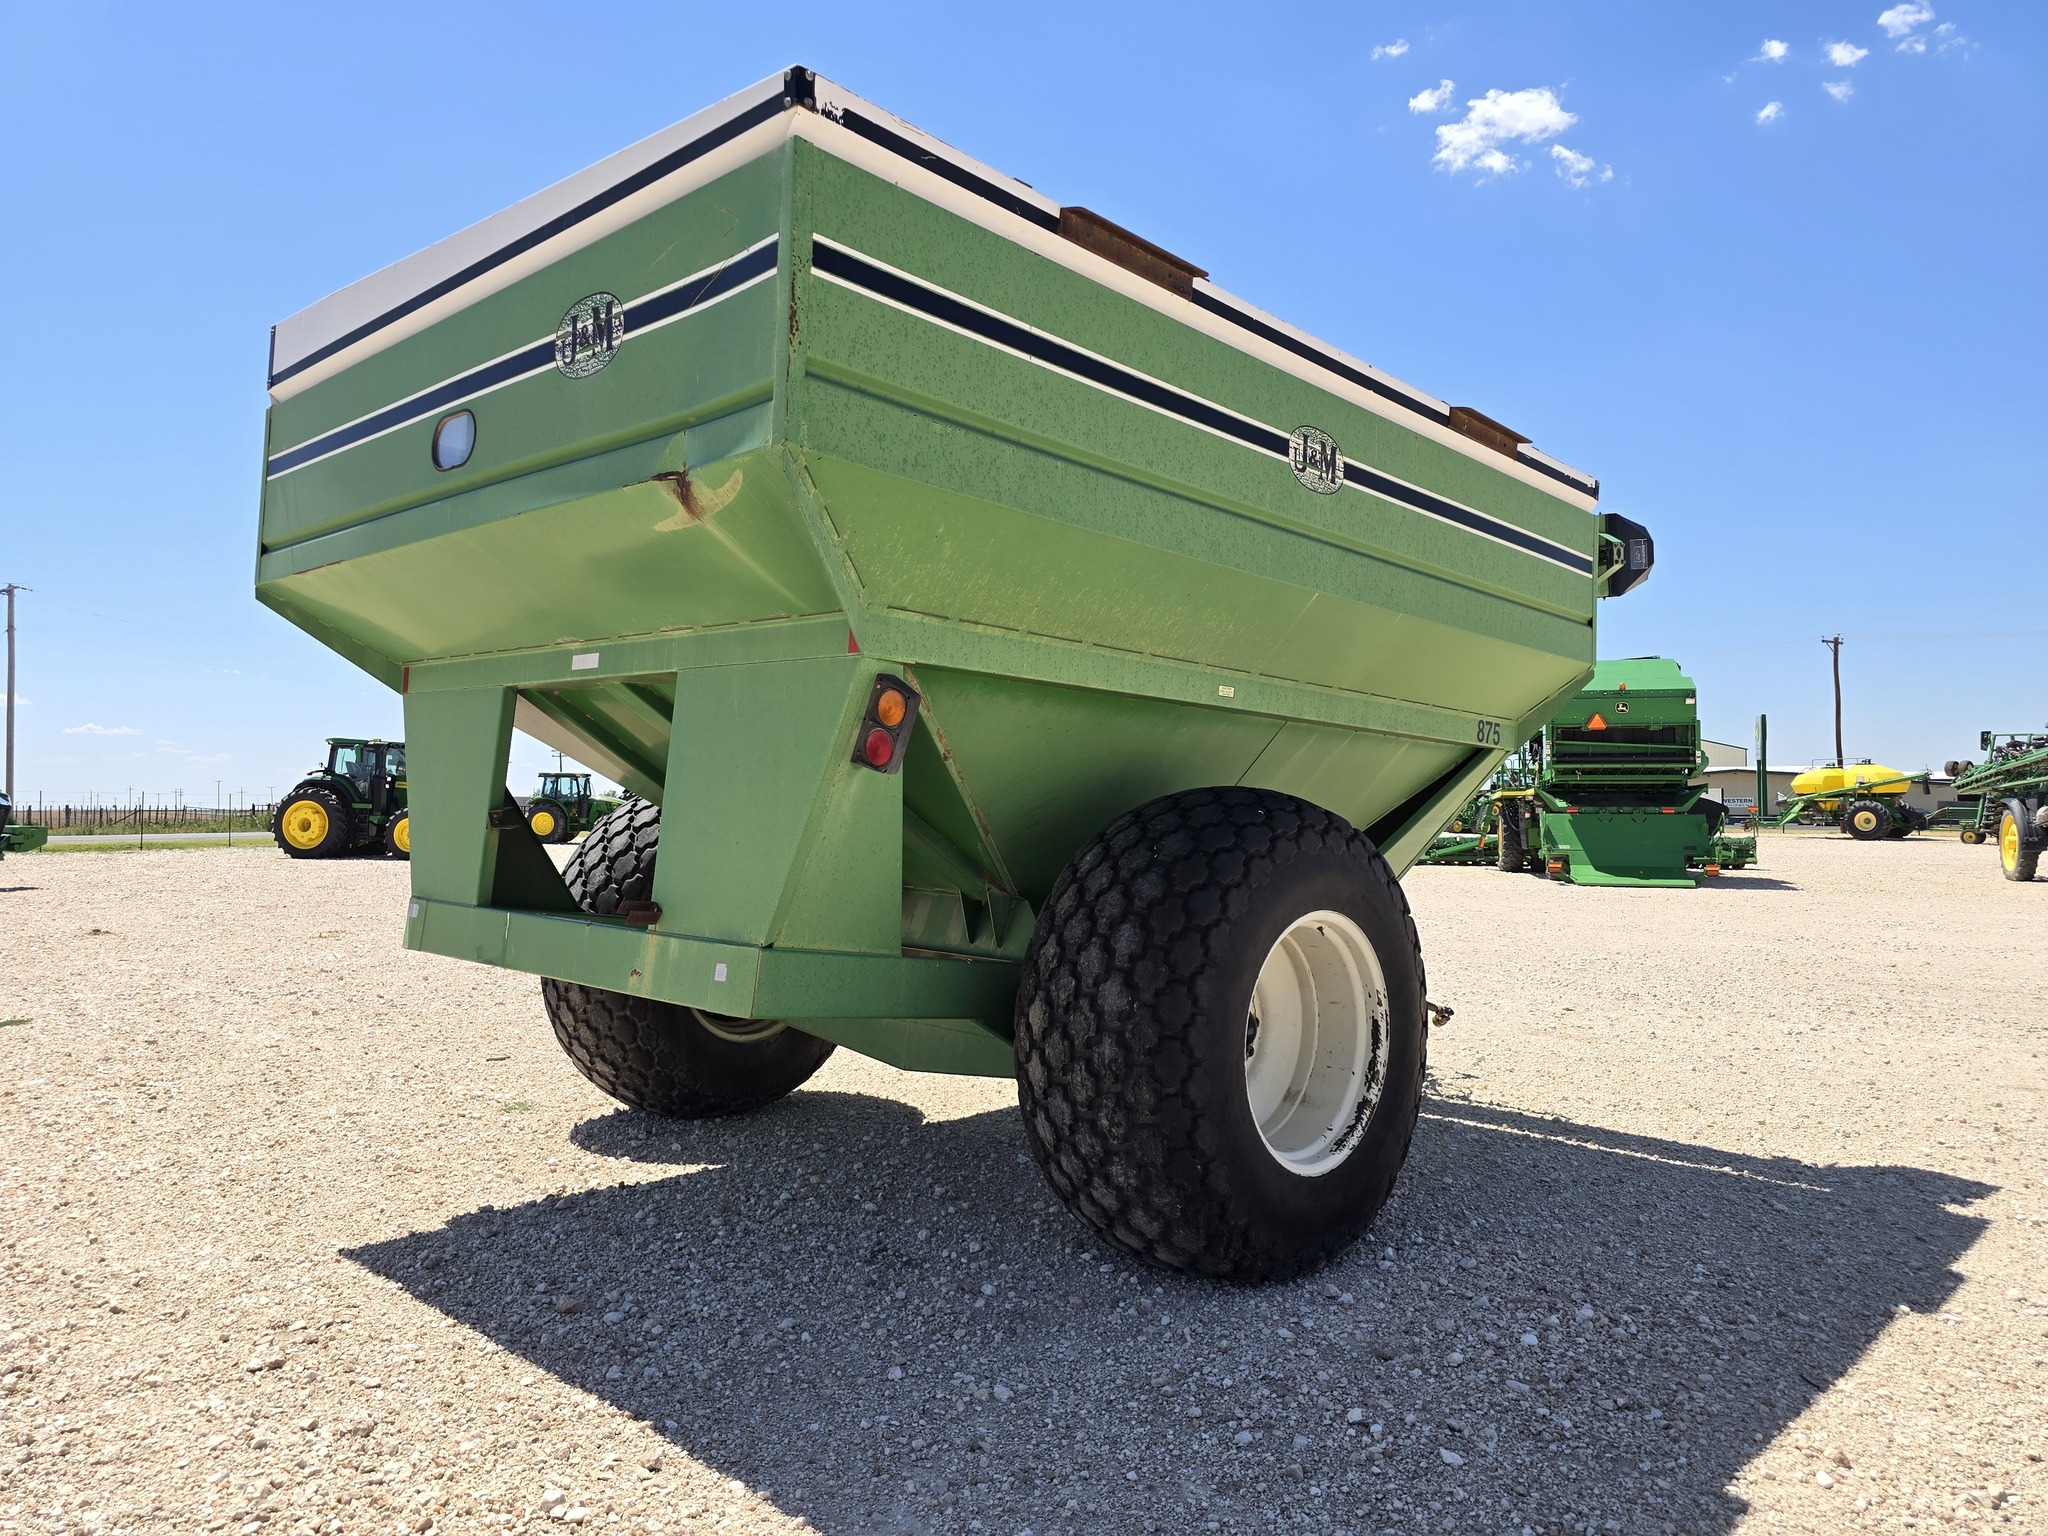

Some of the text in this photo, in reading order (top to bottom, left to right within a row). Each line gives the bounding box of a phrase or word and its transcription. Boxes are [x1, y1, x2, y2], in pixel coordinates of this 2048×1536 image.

[561, 299, 614, 367] J&M
[1293, 433, 1338, 486] J&M
[1476, 719, 1501, 746] 875
